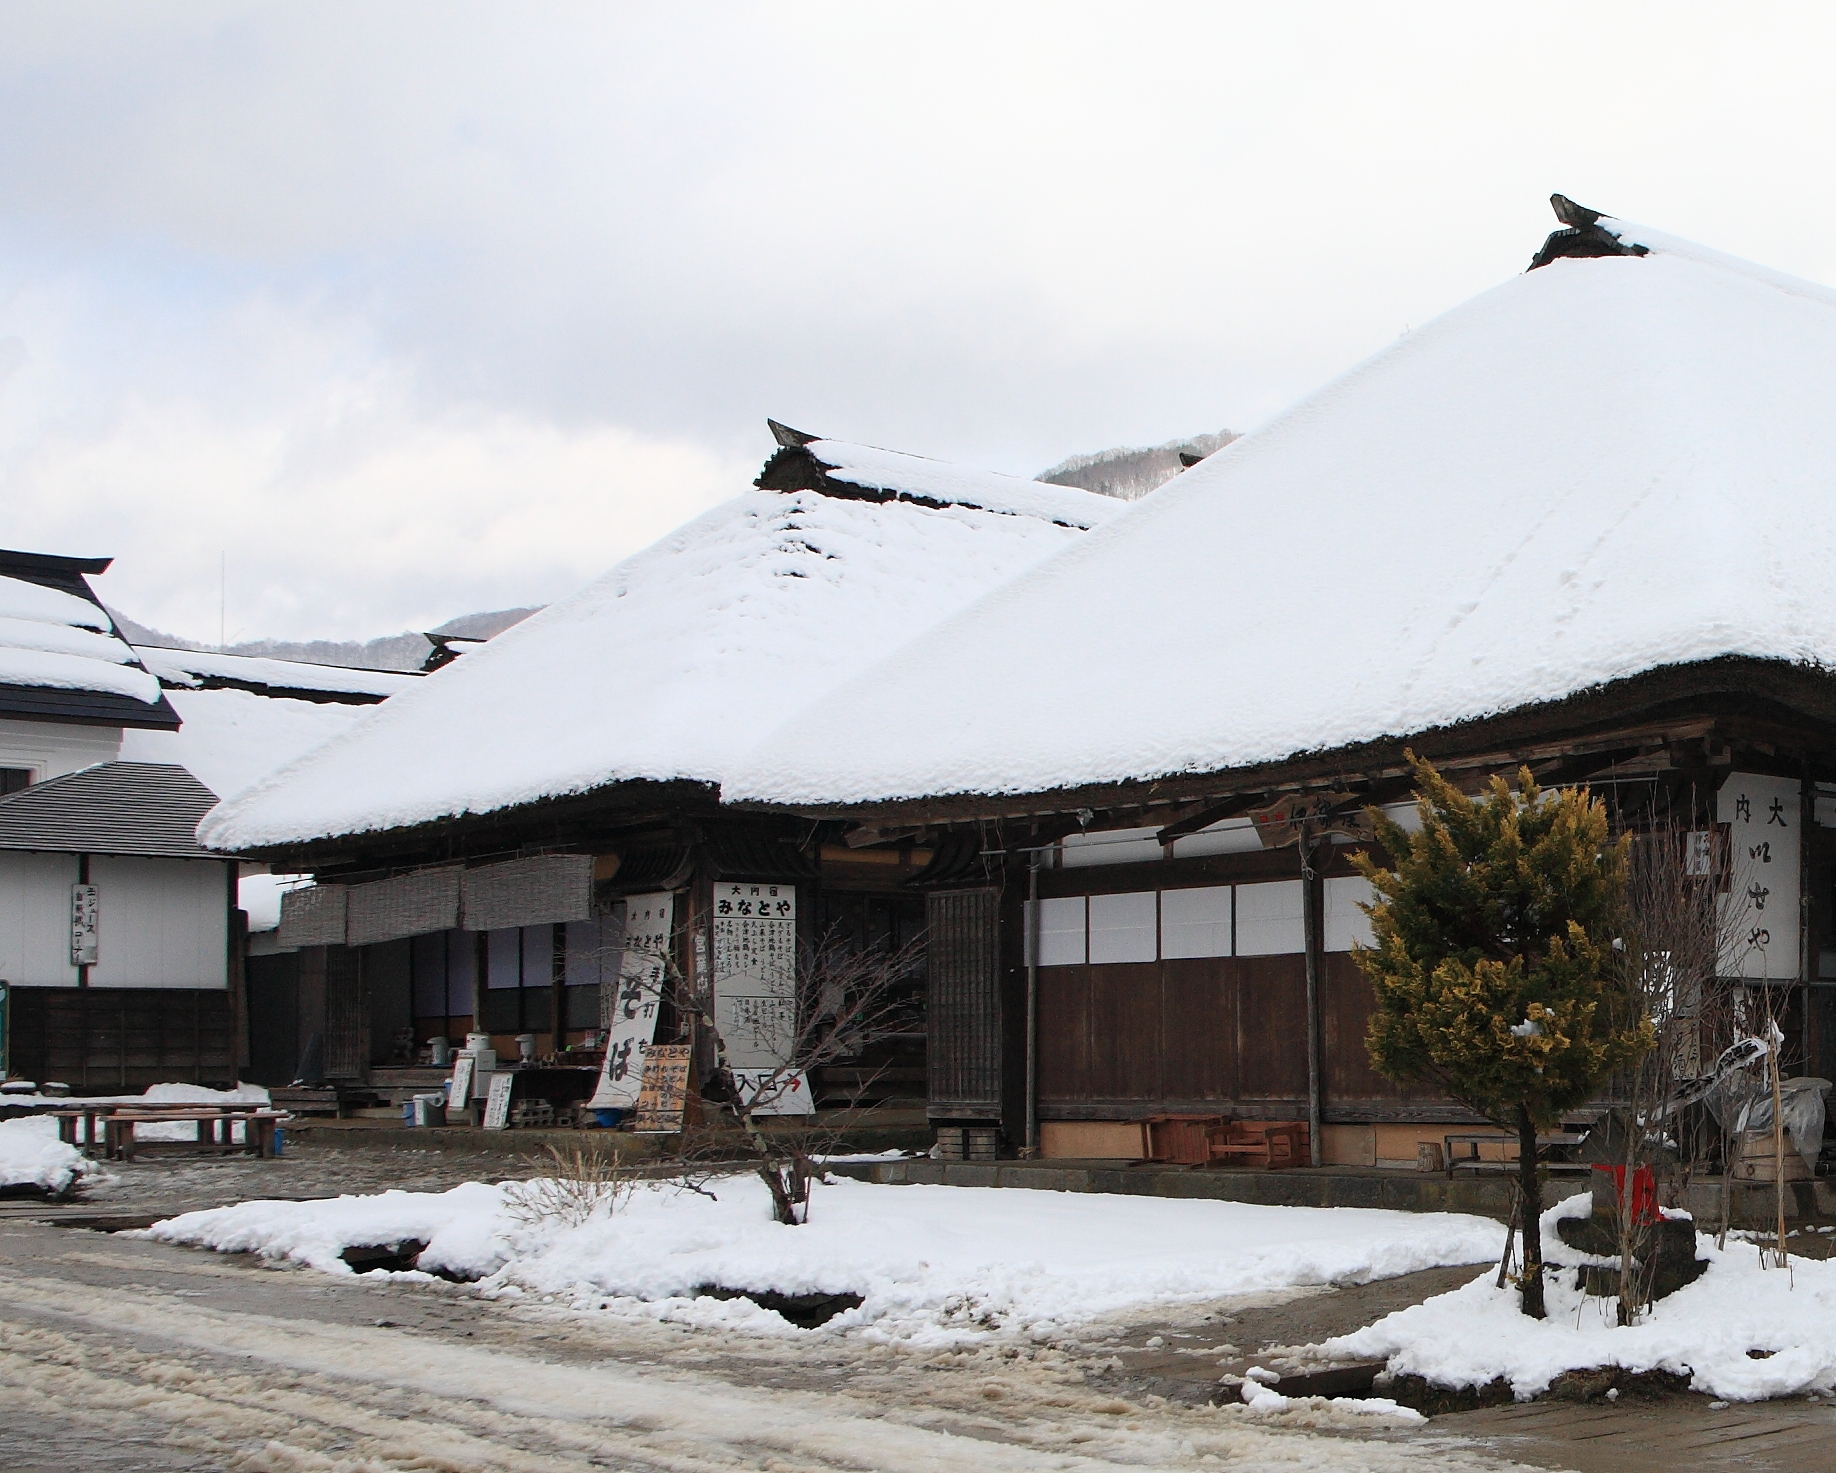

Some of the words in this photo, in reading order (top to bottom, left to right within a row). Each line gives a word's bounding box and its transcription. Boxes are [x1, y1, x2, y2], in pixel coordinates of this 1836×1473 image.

[731, 885, 779, 897] 大内宿
[719, 899, 791, 917] みなとや
